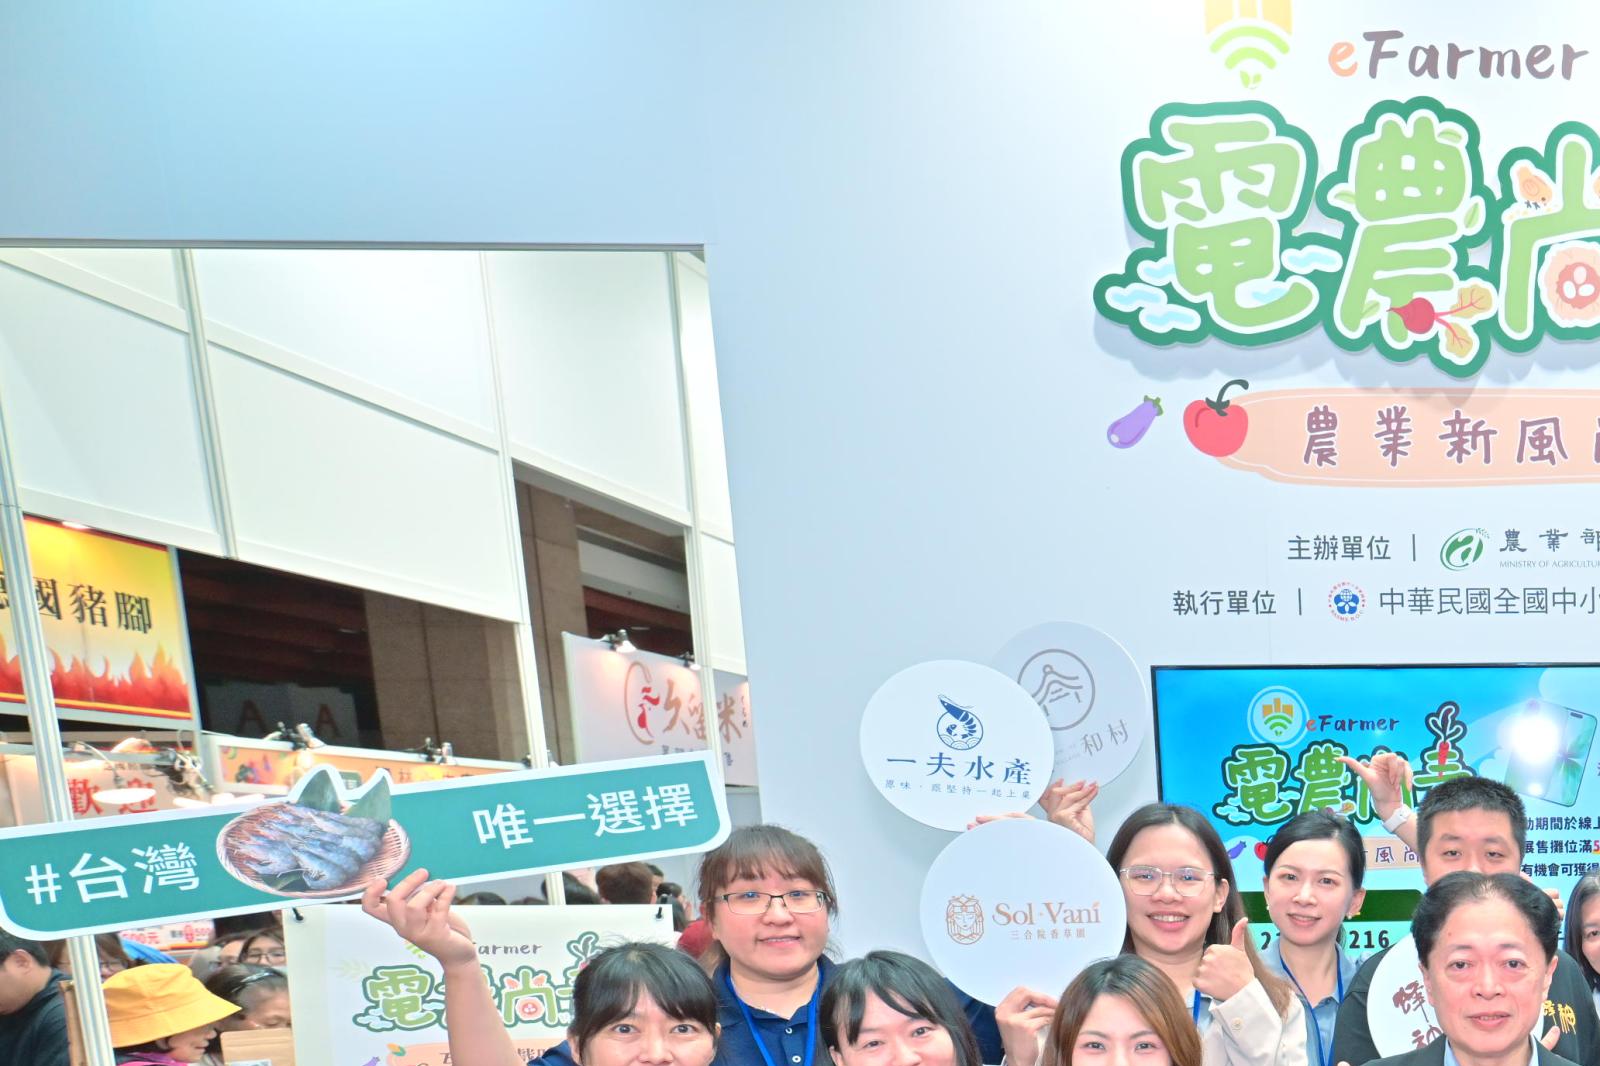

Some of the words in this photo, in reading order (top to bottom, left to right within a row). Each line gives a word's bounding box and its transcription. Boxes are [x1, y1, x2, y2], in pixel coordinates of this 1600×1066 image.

[1329, 31, 1589, 81] eFarmer
[1287, 534, 1391, 561] 主辦單位
[1500, 559, 1536, 568] MINISTRY
[1539, 560, 1550, 568] OF
[1173, 588, 1277, 617] 執行單位
[1081, 719, 1129, 757] 和村
[1306, 714, 1400, 732] eFarmer
[887, 752, 1032, 786] 一夫水產
[1214, 740, 1475, 823] 電農青
[472, 783, 698, 849] 唯一選擇
[1365, 845, 1420, 864] 風尚
[25, 842, 200, 904] #台灣
[474, 941, 543, 956] armer
